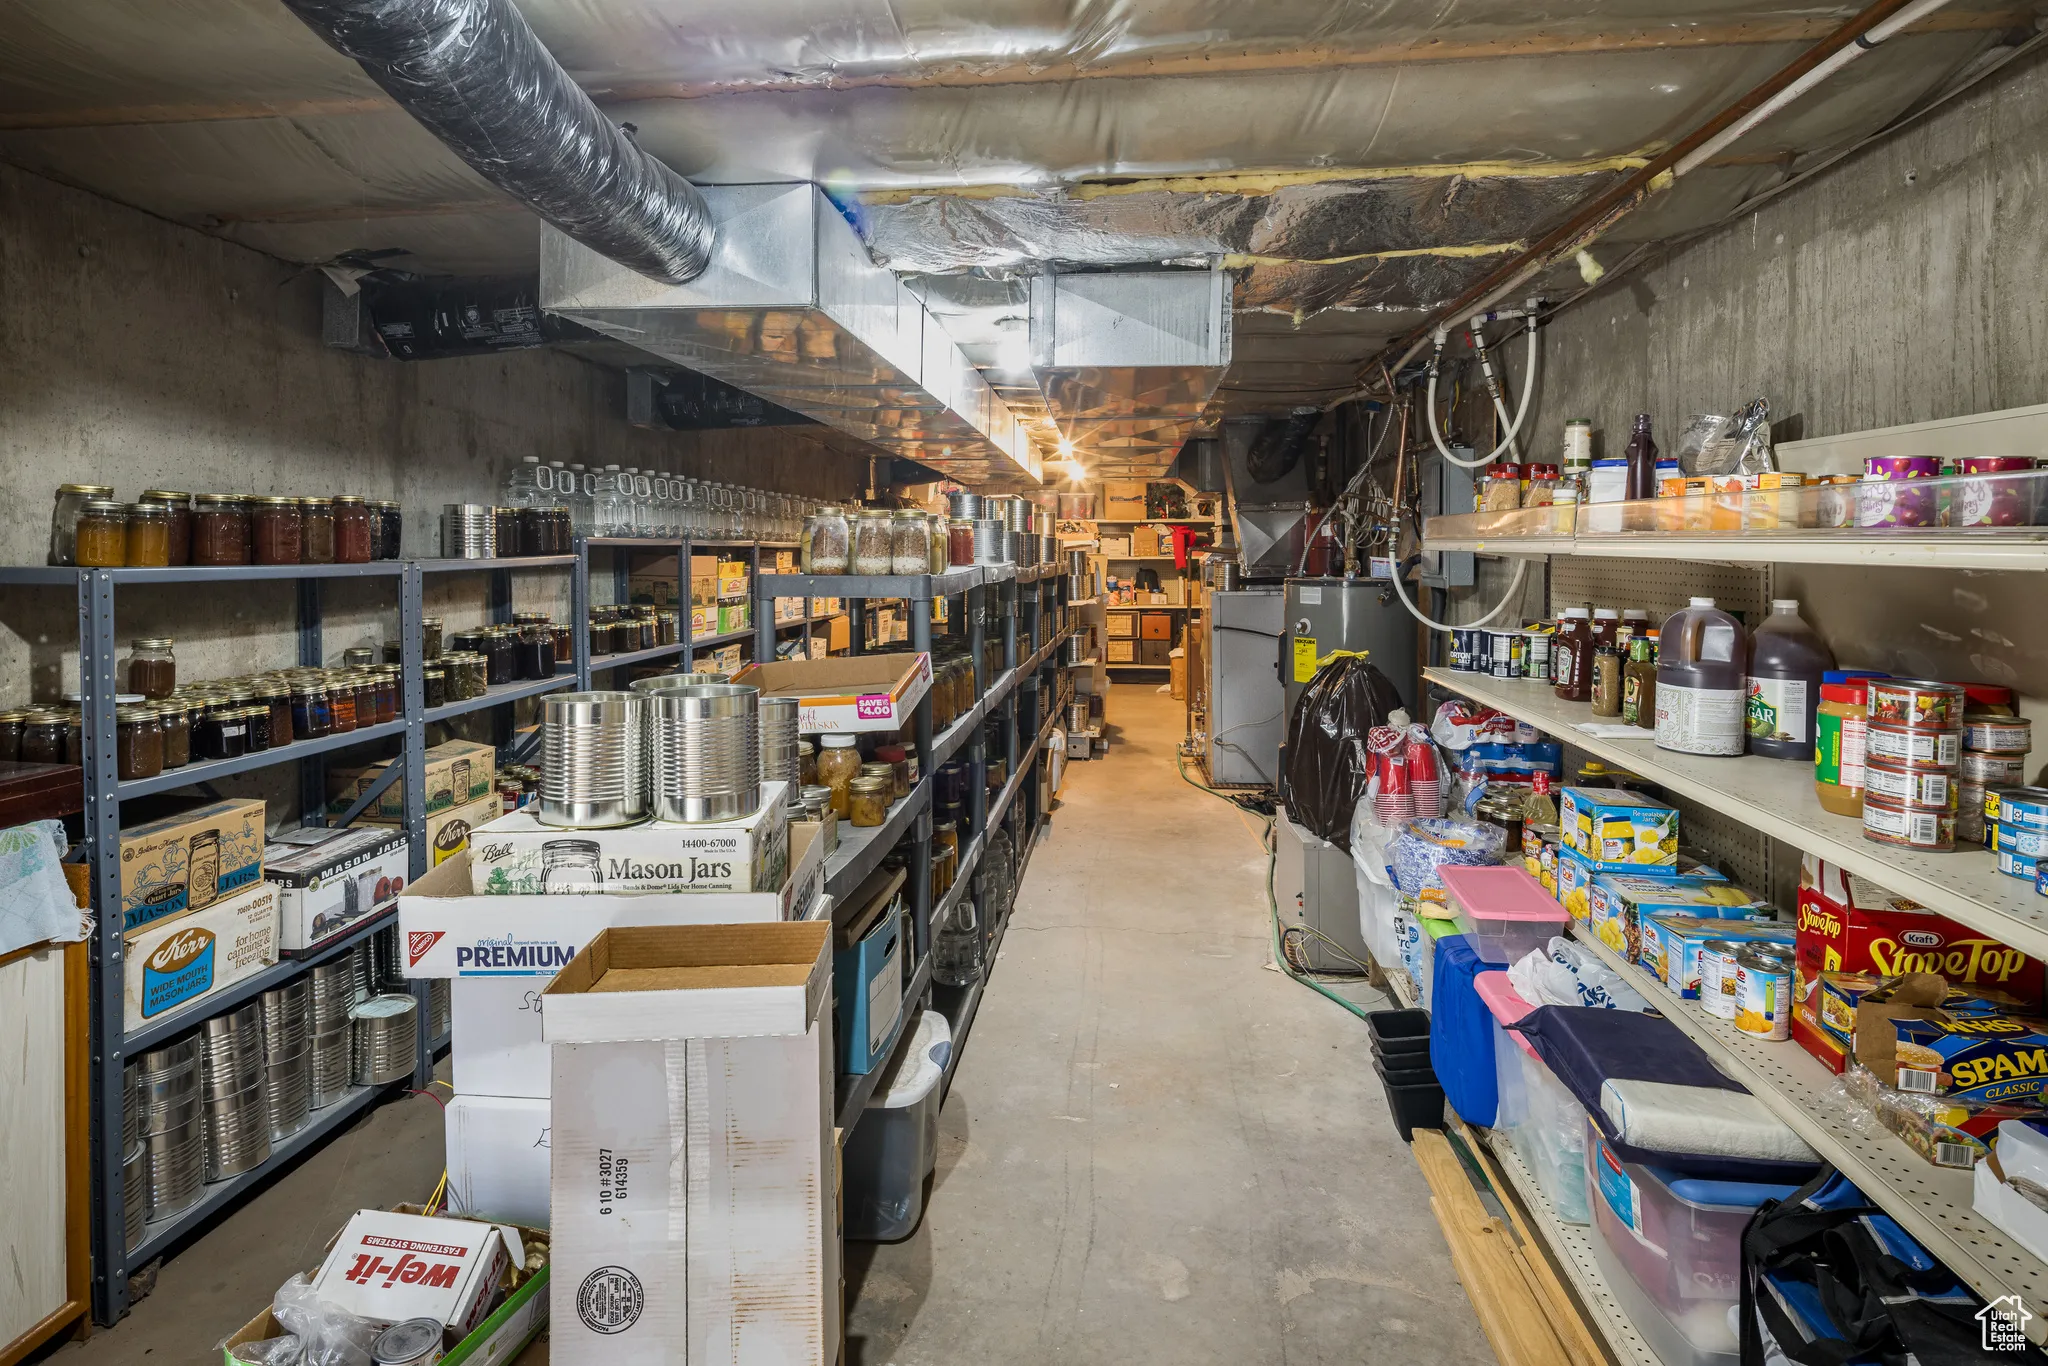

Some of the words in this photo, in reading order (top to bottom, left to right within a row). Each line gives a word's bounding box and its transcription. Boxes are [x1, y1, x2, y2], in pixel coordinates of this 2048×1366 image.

[860, 706, 890, 716] $4.00
[482, 842, 516, 863] Ball
[682, 838, 736, 848] 14400-67000
[321, 852, 372, 880] MASON
[376, 837, 406, 856] JARS
[608, 857, 684, 880] Mason
[688, 856, 732, 884] Jars
[708, 882, 732, 890] Canning
[126, 896, 186, 928] MASON
[220, 870, 256, 891] JARS
[1594, 896, 1605, 910] Dole
[227, 940, 263, 961] canning
[264, 934, 270, 944] &
[236, 934, 248, 948] for
[248, 926, 272, 942] home
[412, 935, 432, 954] NABISCO
[477, 932, 513, 954] original
[1908, 934, 1934, 944] Kraft
[152, 929, 210, 970] Kerr
[234, 946, 270, 970] freezing
[456, 946, 574, 967] PREMIUM
[150, 980, 175, 996] WIDE
[176, 964, 208, 985] MOUTH
[150, 986, 184, 1008] MASON
[185, 974, 208, 992] JARS
[1985, 1081, 2040, 1098] CLASSIC
[600, 1148, 612, 1187] #3027
[615, 1158, 628, 1200] 614359
[600, 1190, 612, 1206] 10
[600, 1207, 612, 1215] 6
[366, 1236, 409, 1248] SYSTEMS
[410, 1242, 461, 1256] FASTENING
